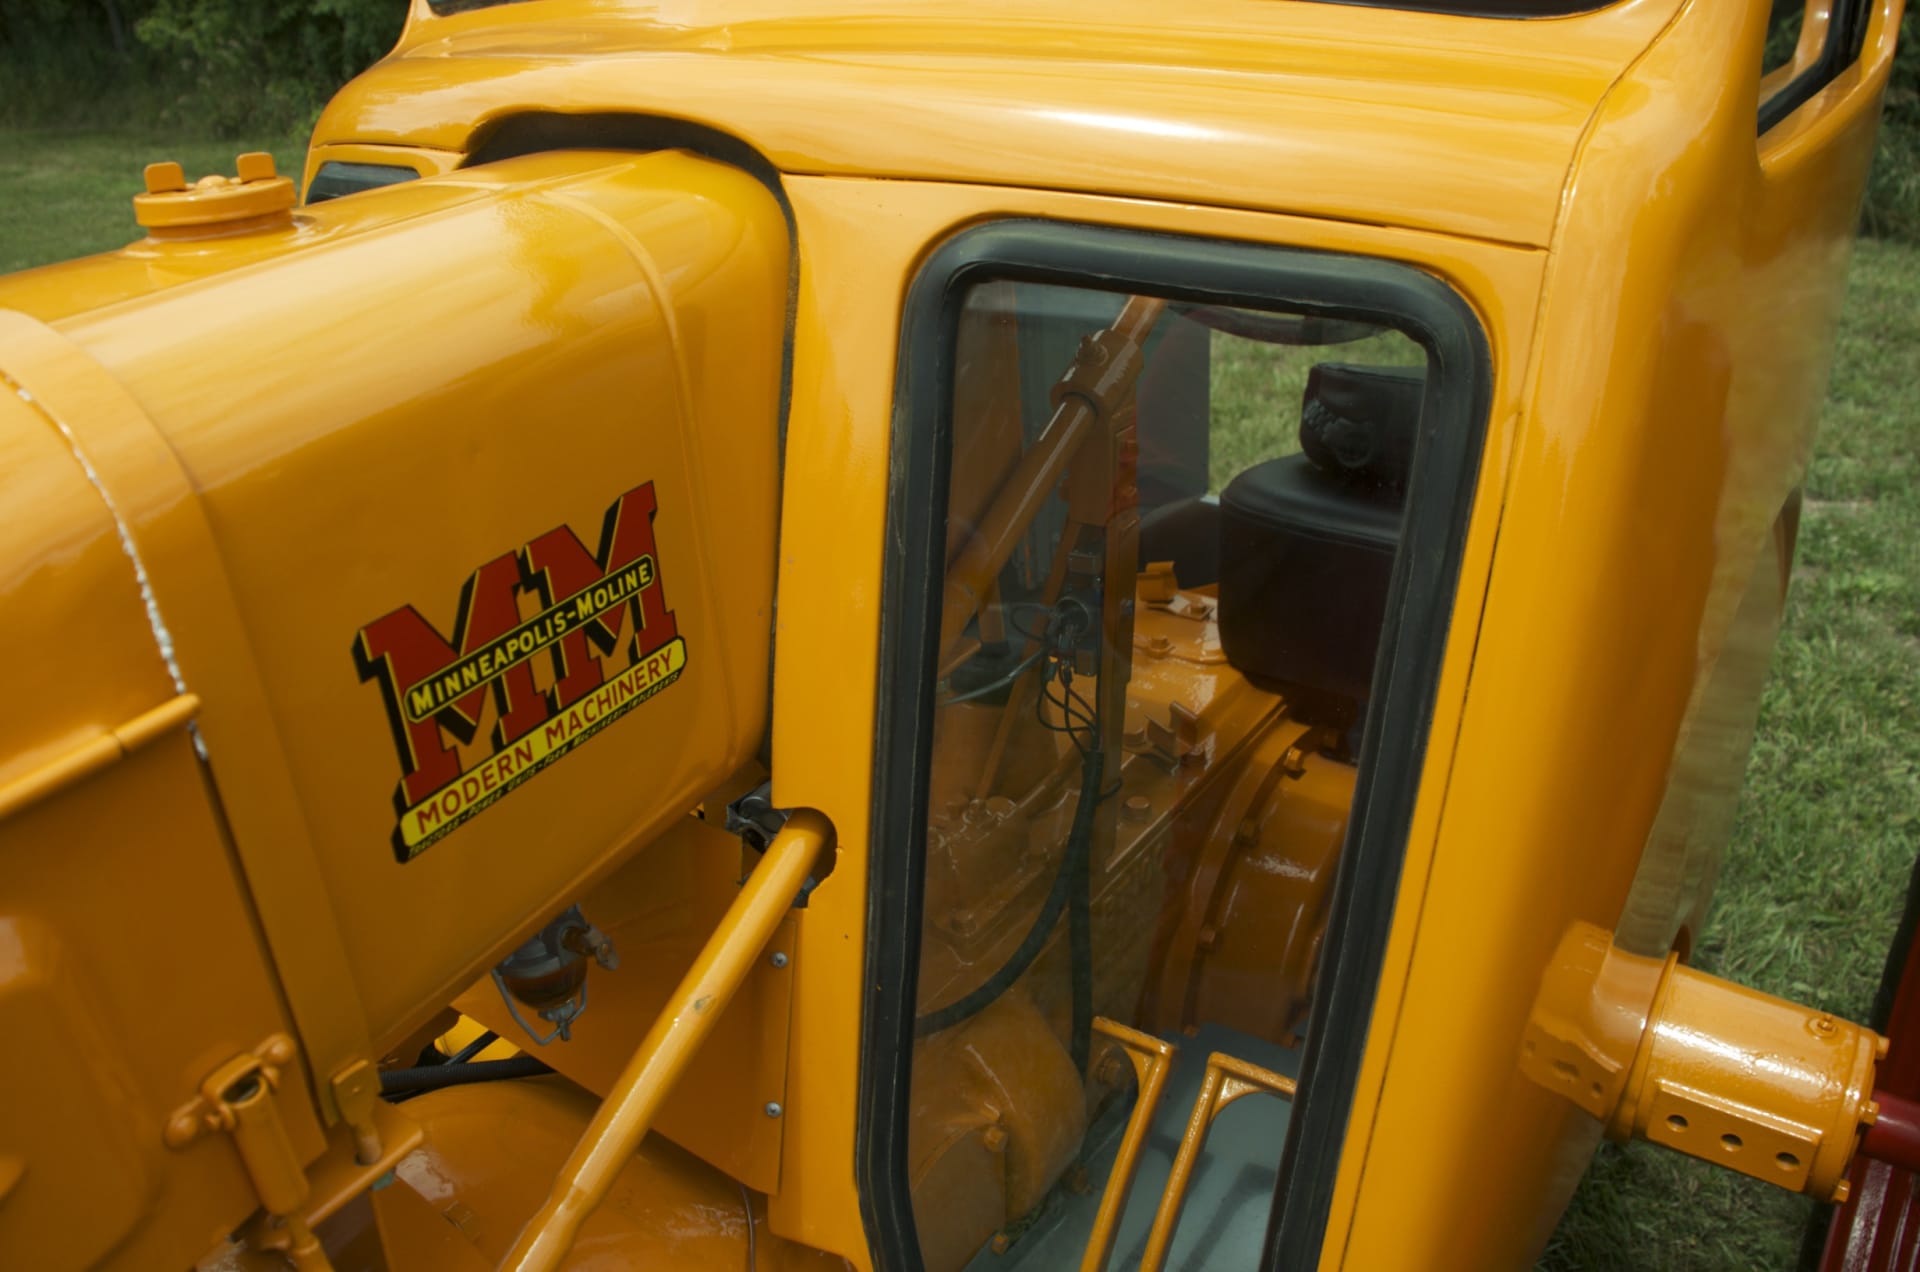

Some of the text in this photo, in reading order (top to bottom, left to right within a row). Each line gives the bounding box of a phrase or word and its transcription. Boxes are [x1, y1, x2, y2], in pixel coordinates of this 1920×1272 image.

[410, 563, 650, 716] MINNEAPOLIS-MOLINE
[415, 648, 672, 834] MODERN MACHINERY
